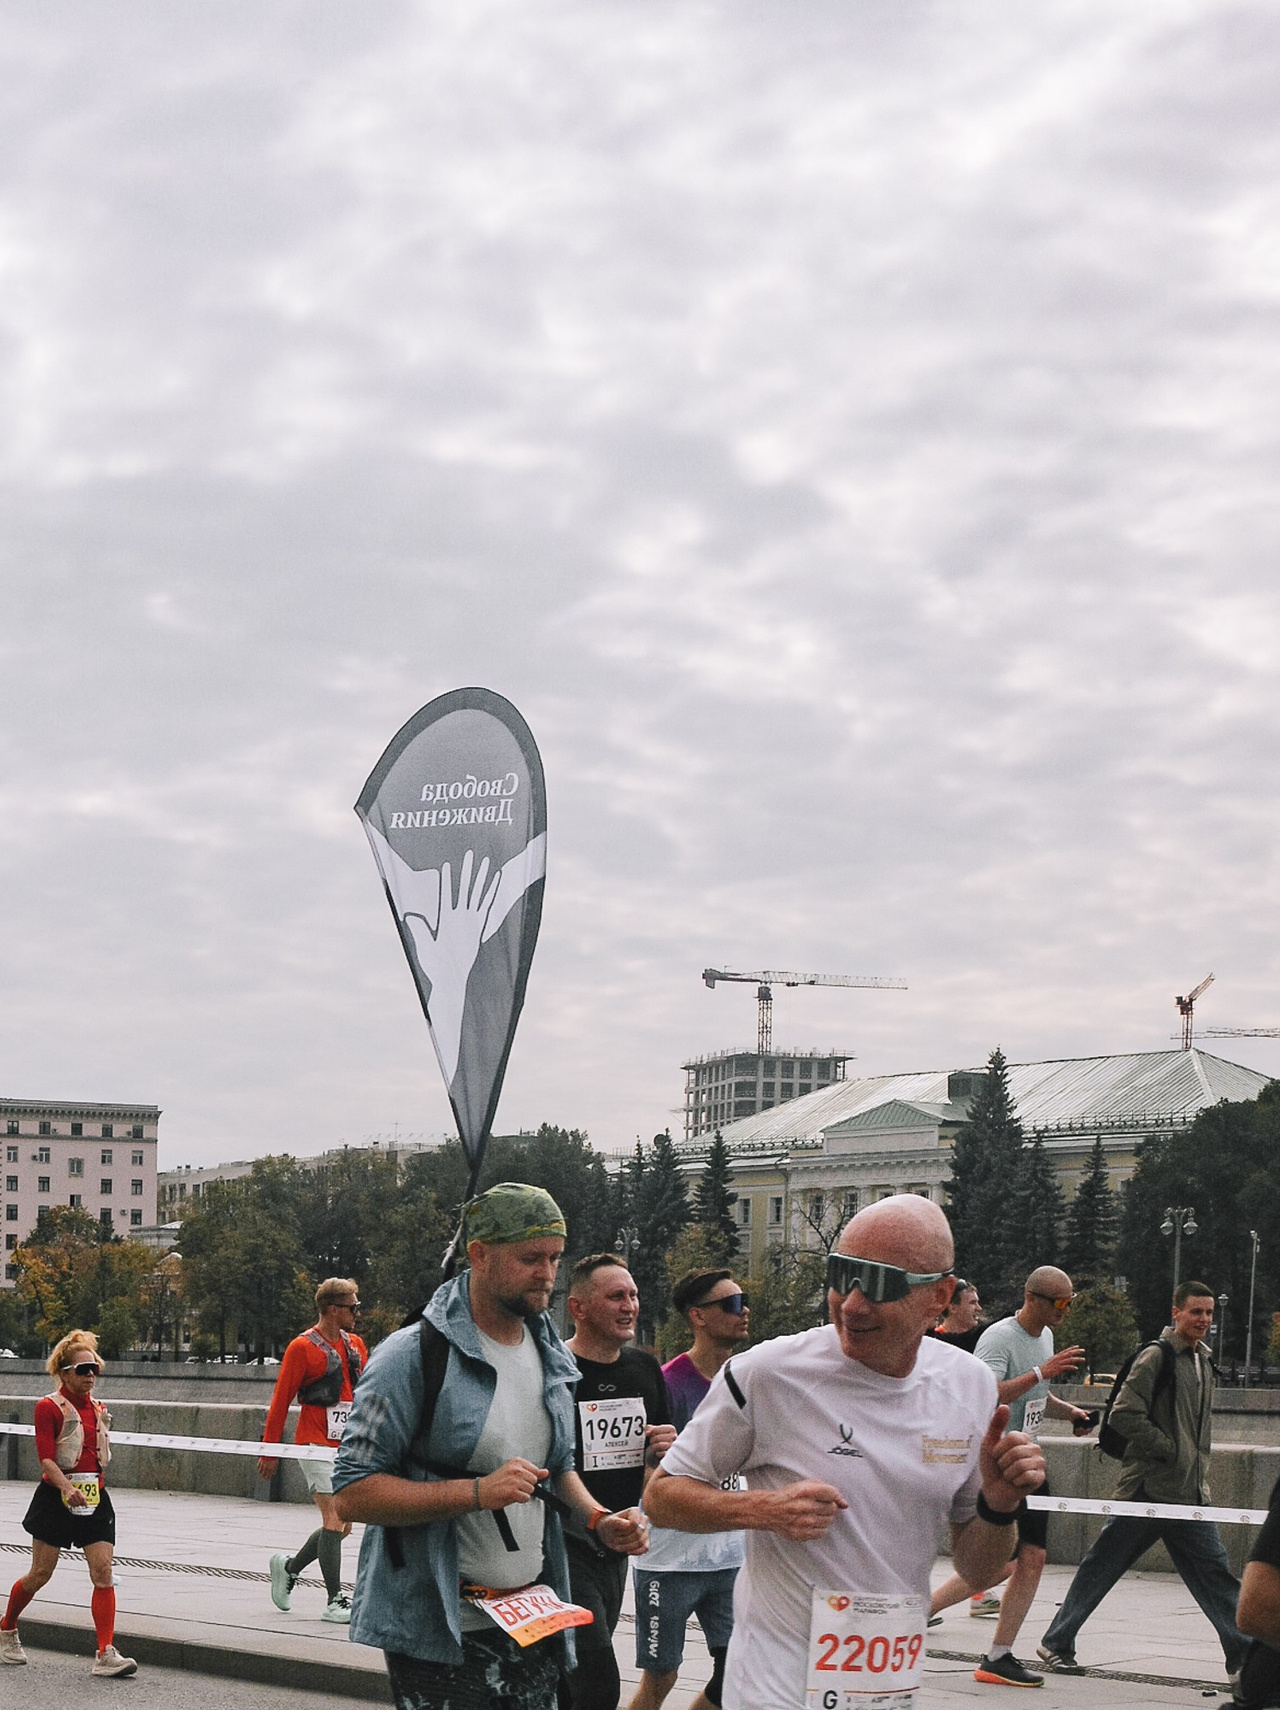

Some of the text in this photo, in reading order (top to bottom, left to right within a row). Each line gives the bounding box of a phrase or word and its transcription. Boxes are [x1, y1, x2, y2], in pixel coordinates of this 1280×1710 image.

[333, 1411, 351, 1423] 73
[586, 1415, 644, 1440] 19673
[648, 1581, 660, 1607] 2019
[815, 1633, 923, 1673] 22059
[823, 1690, 838, 1710] G
